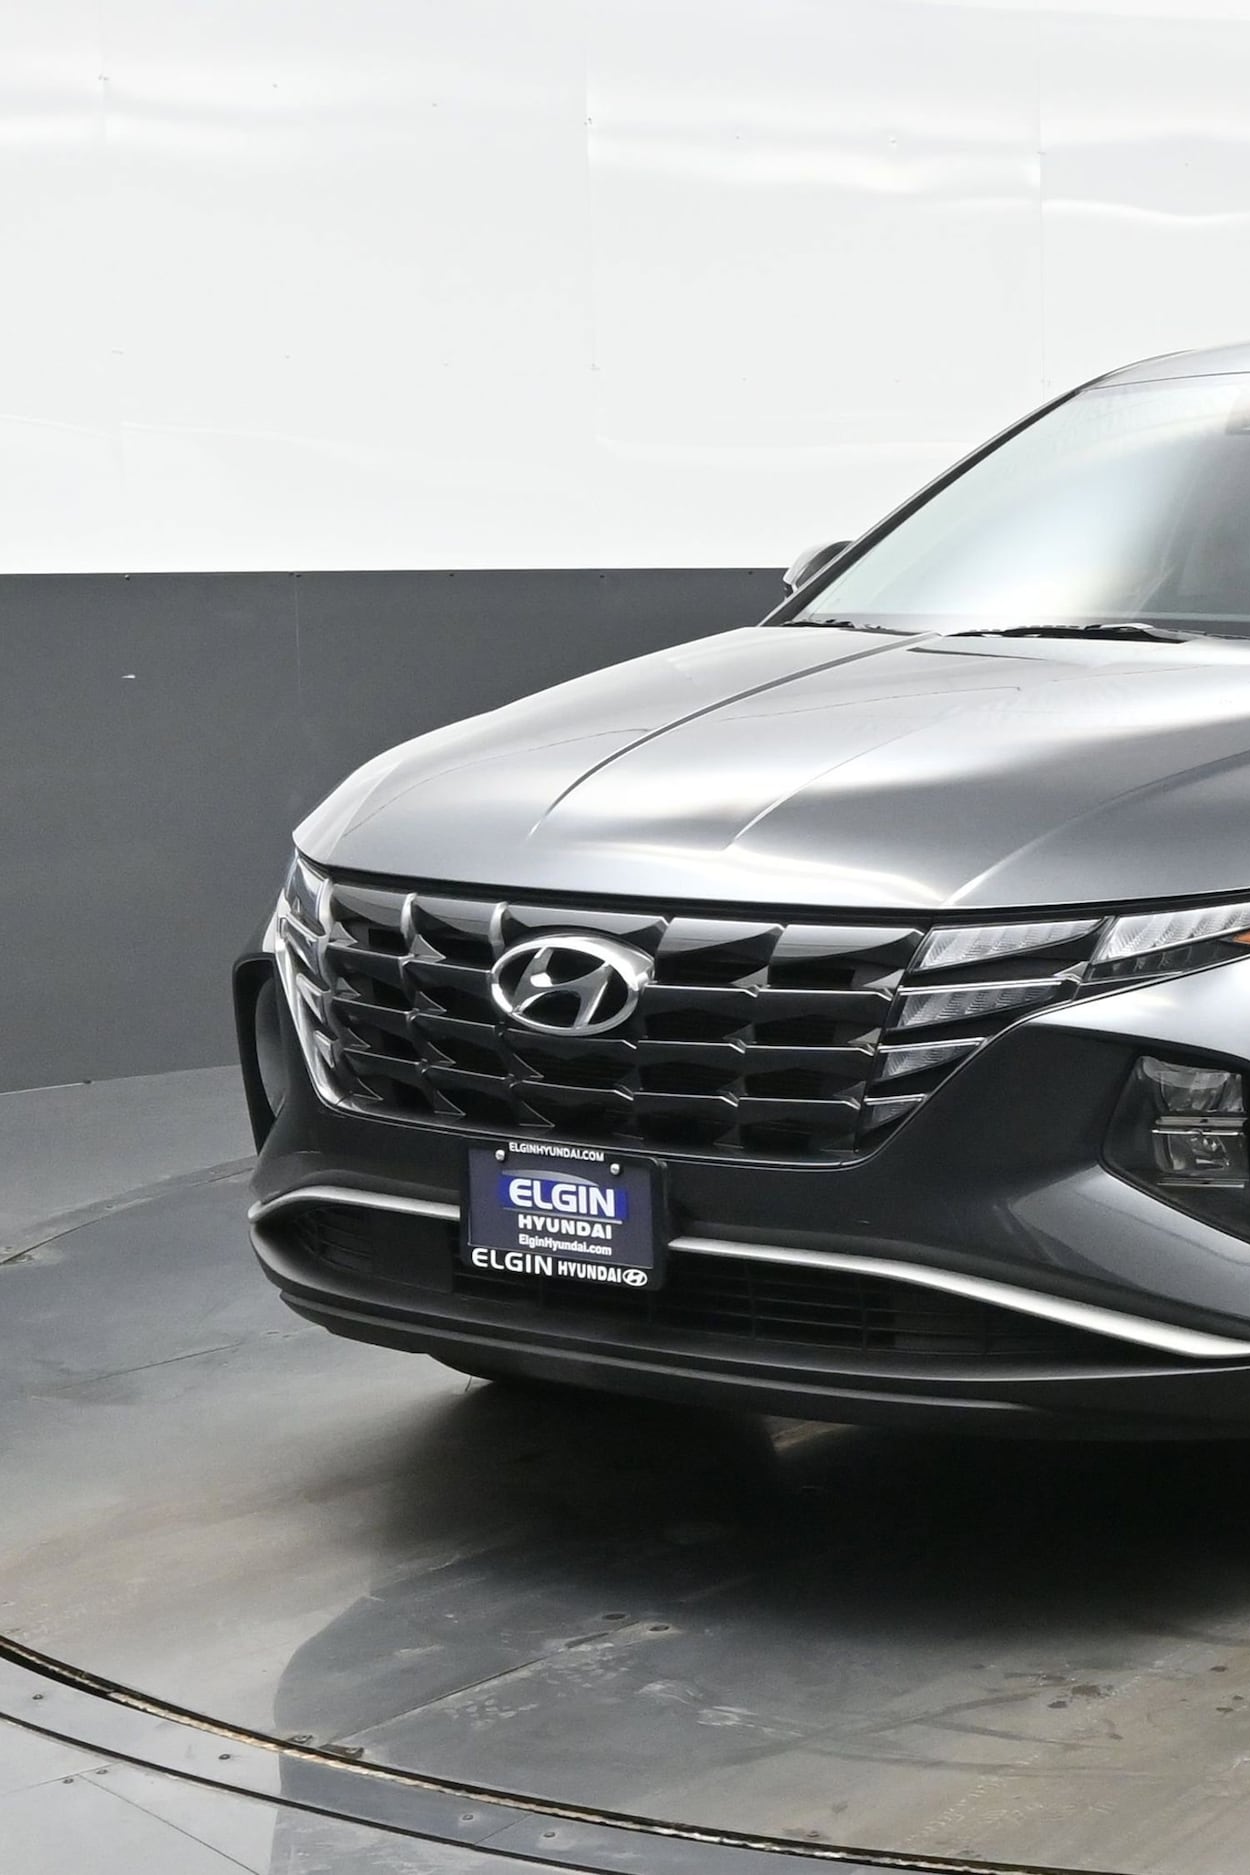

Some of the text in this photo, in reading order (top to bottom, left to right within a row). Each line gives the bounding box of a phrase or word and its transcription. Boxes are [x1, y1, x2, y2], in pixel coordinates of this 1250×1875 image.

[509, 1142, 604, 1162] ELGINHYUNDAI.COM
[509, 1178, 615, 1217] ELGIN
[518, 1214, 612, 1239] HYUNDAI
[519, 1234, 612, 1256] ElginHyundai.com
[471, 1248, 621, 1283] ELGIN HYUNDAI
